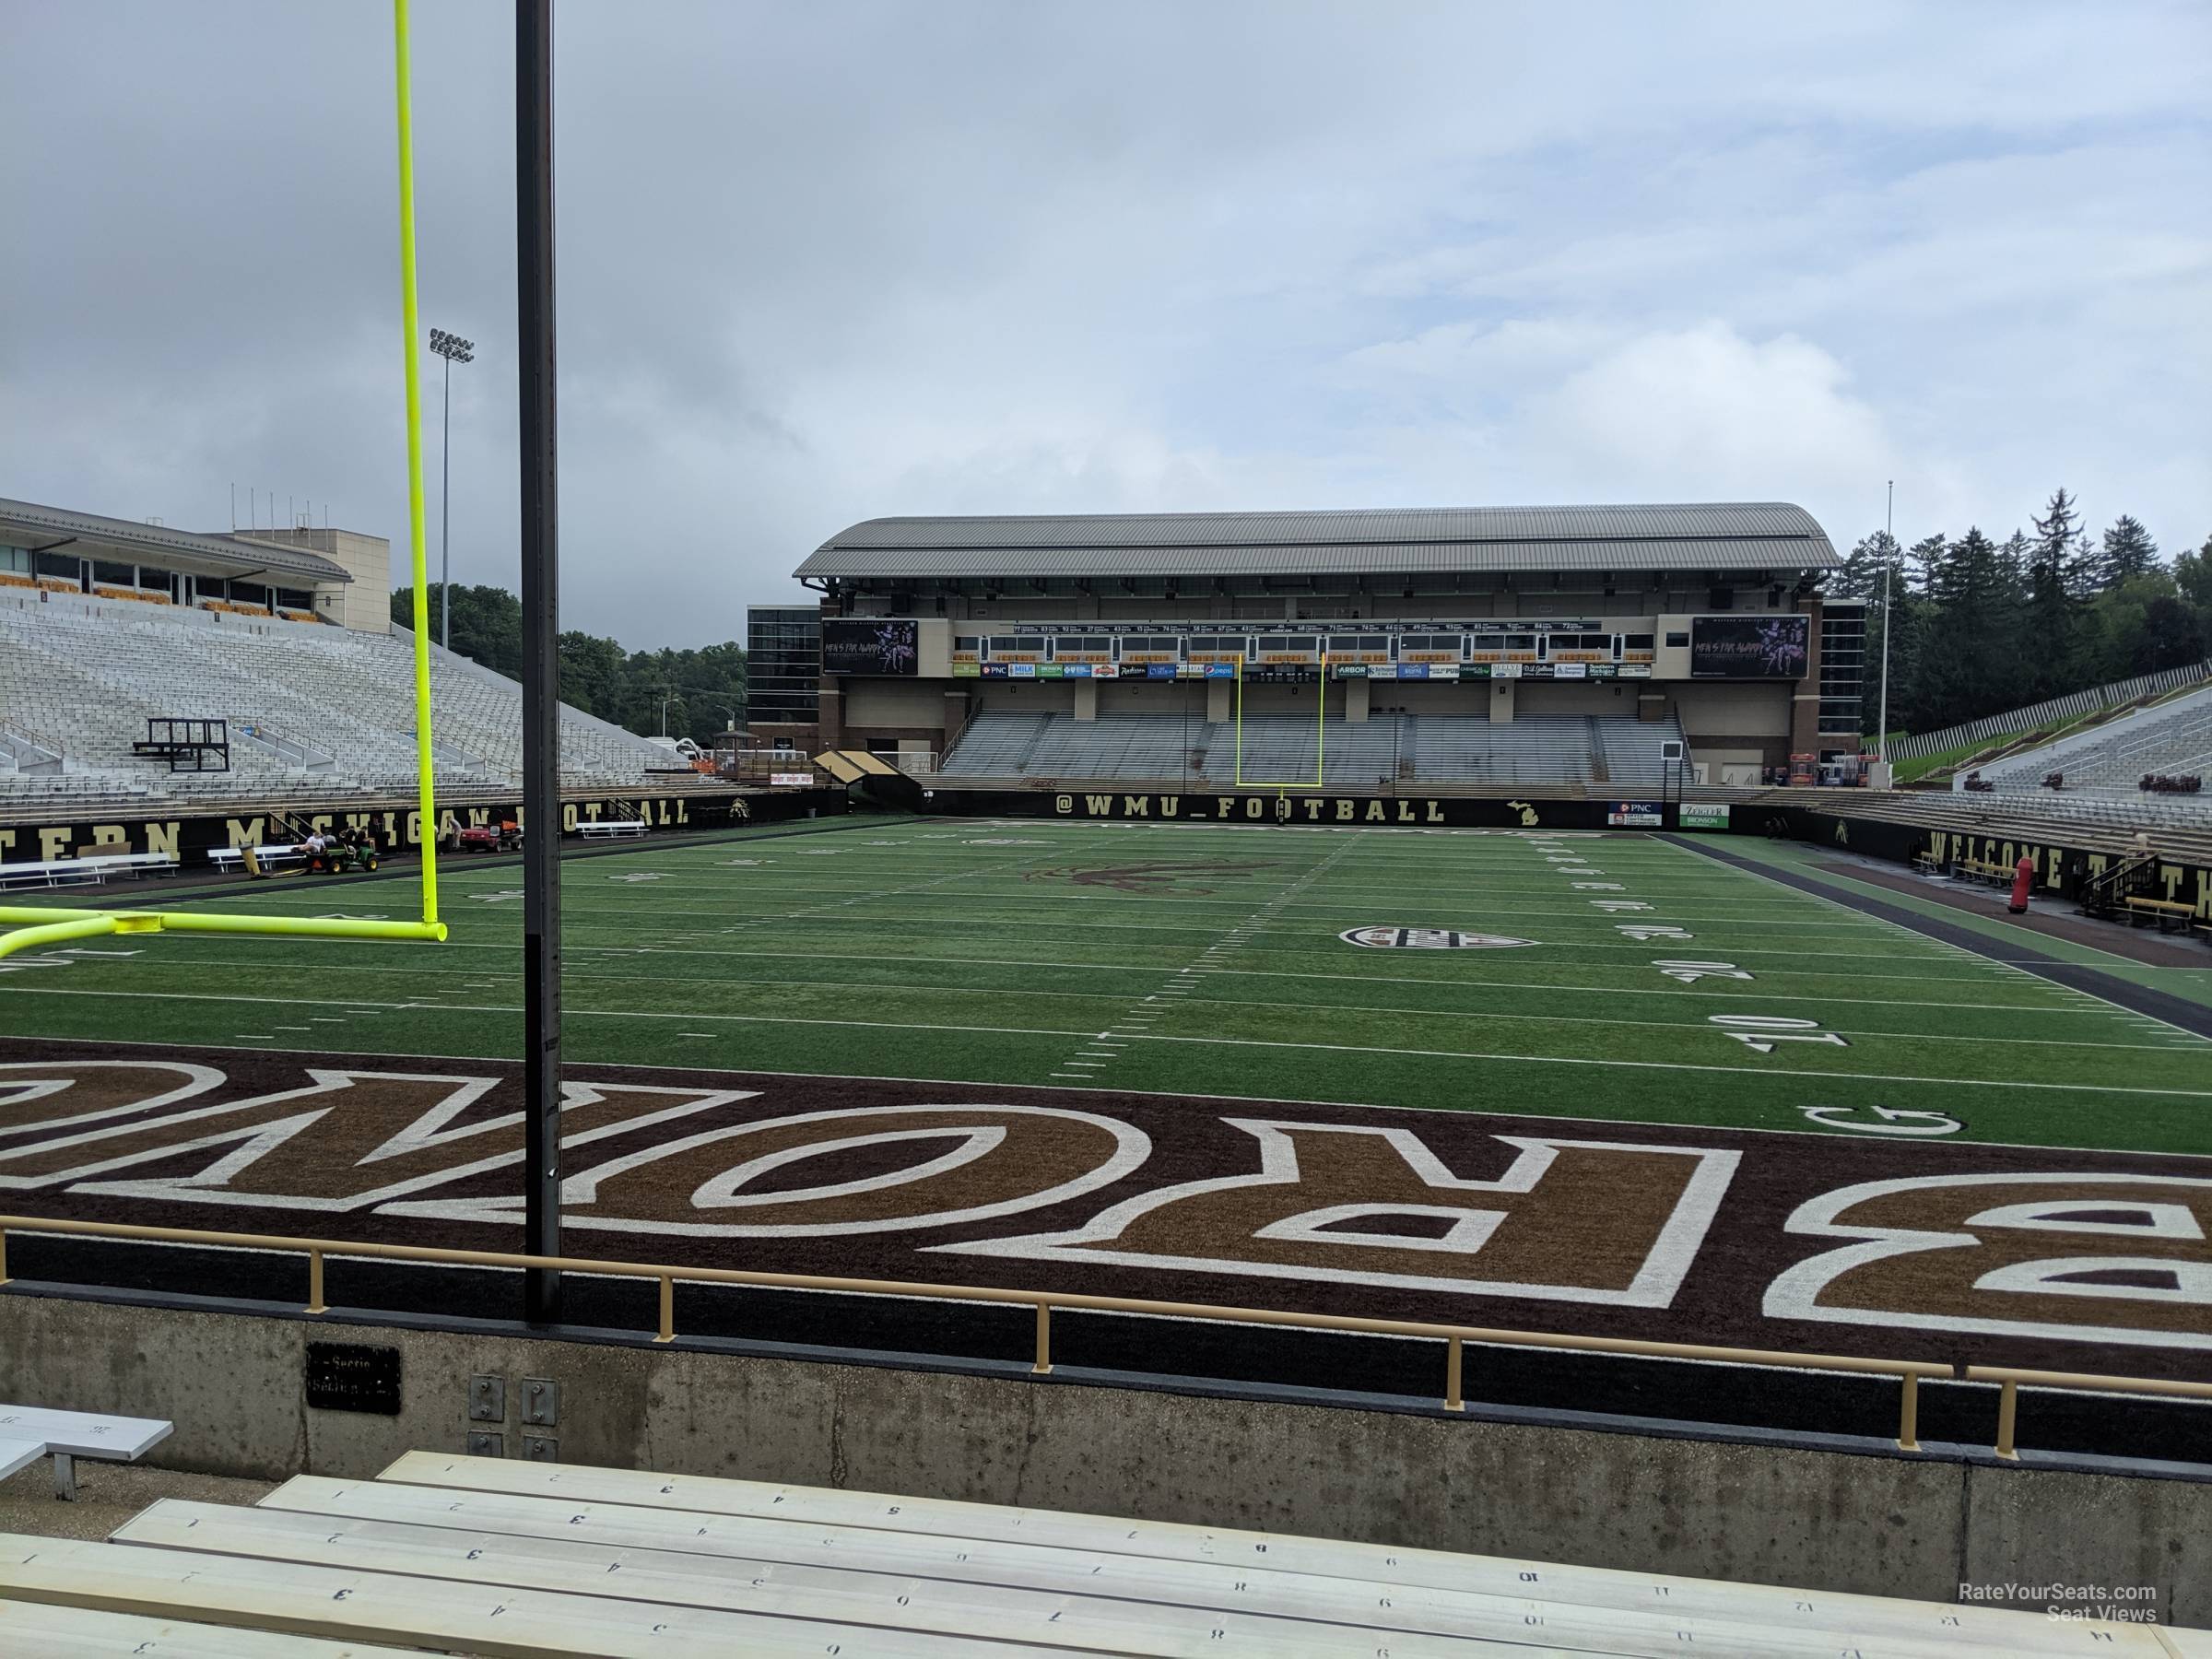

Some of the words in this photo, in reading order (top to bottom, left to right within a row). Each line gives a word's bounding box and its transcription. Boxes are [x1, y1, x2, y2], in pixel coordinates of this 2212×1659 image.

[991, 665, 1006, 674] PNC
[1015, 665, 1033, 673] MILK
[1215, 666, 1233, 677] pepsi
[1630, 804, 1652, 812] PNC
[227, 808, 489, 849] MCHIGAN
[1651, 960, 1755, 980] 20
[1707, 1015, 1850, 1047] 10
[1798, 1105, 1965, 1135] 5
[332, 1490, 344, 1499] 1
[659, 1486, 674, 1494] 3
[773, 1496, 784, 1504] 4
[449, 1501, 465, 1512] 2
[887, 1506, 900, 1515] 5
[569, 1514, 586, 1524] 3
[697, 1527, 708, 1536] 4
[326, 1532, 345, 1544] 2
[465, 1548, 483, 1560] 3
[1255, 1544, 1267, 1553] 8
[21, 1554, 38, 1565] 1
[606, 1562, 621, 1573] 4
[1519, 1571, 1538, 1583] 10
[332, 1588, 353, 1601] 3
[489, 1605, 506, 1617] 4
